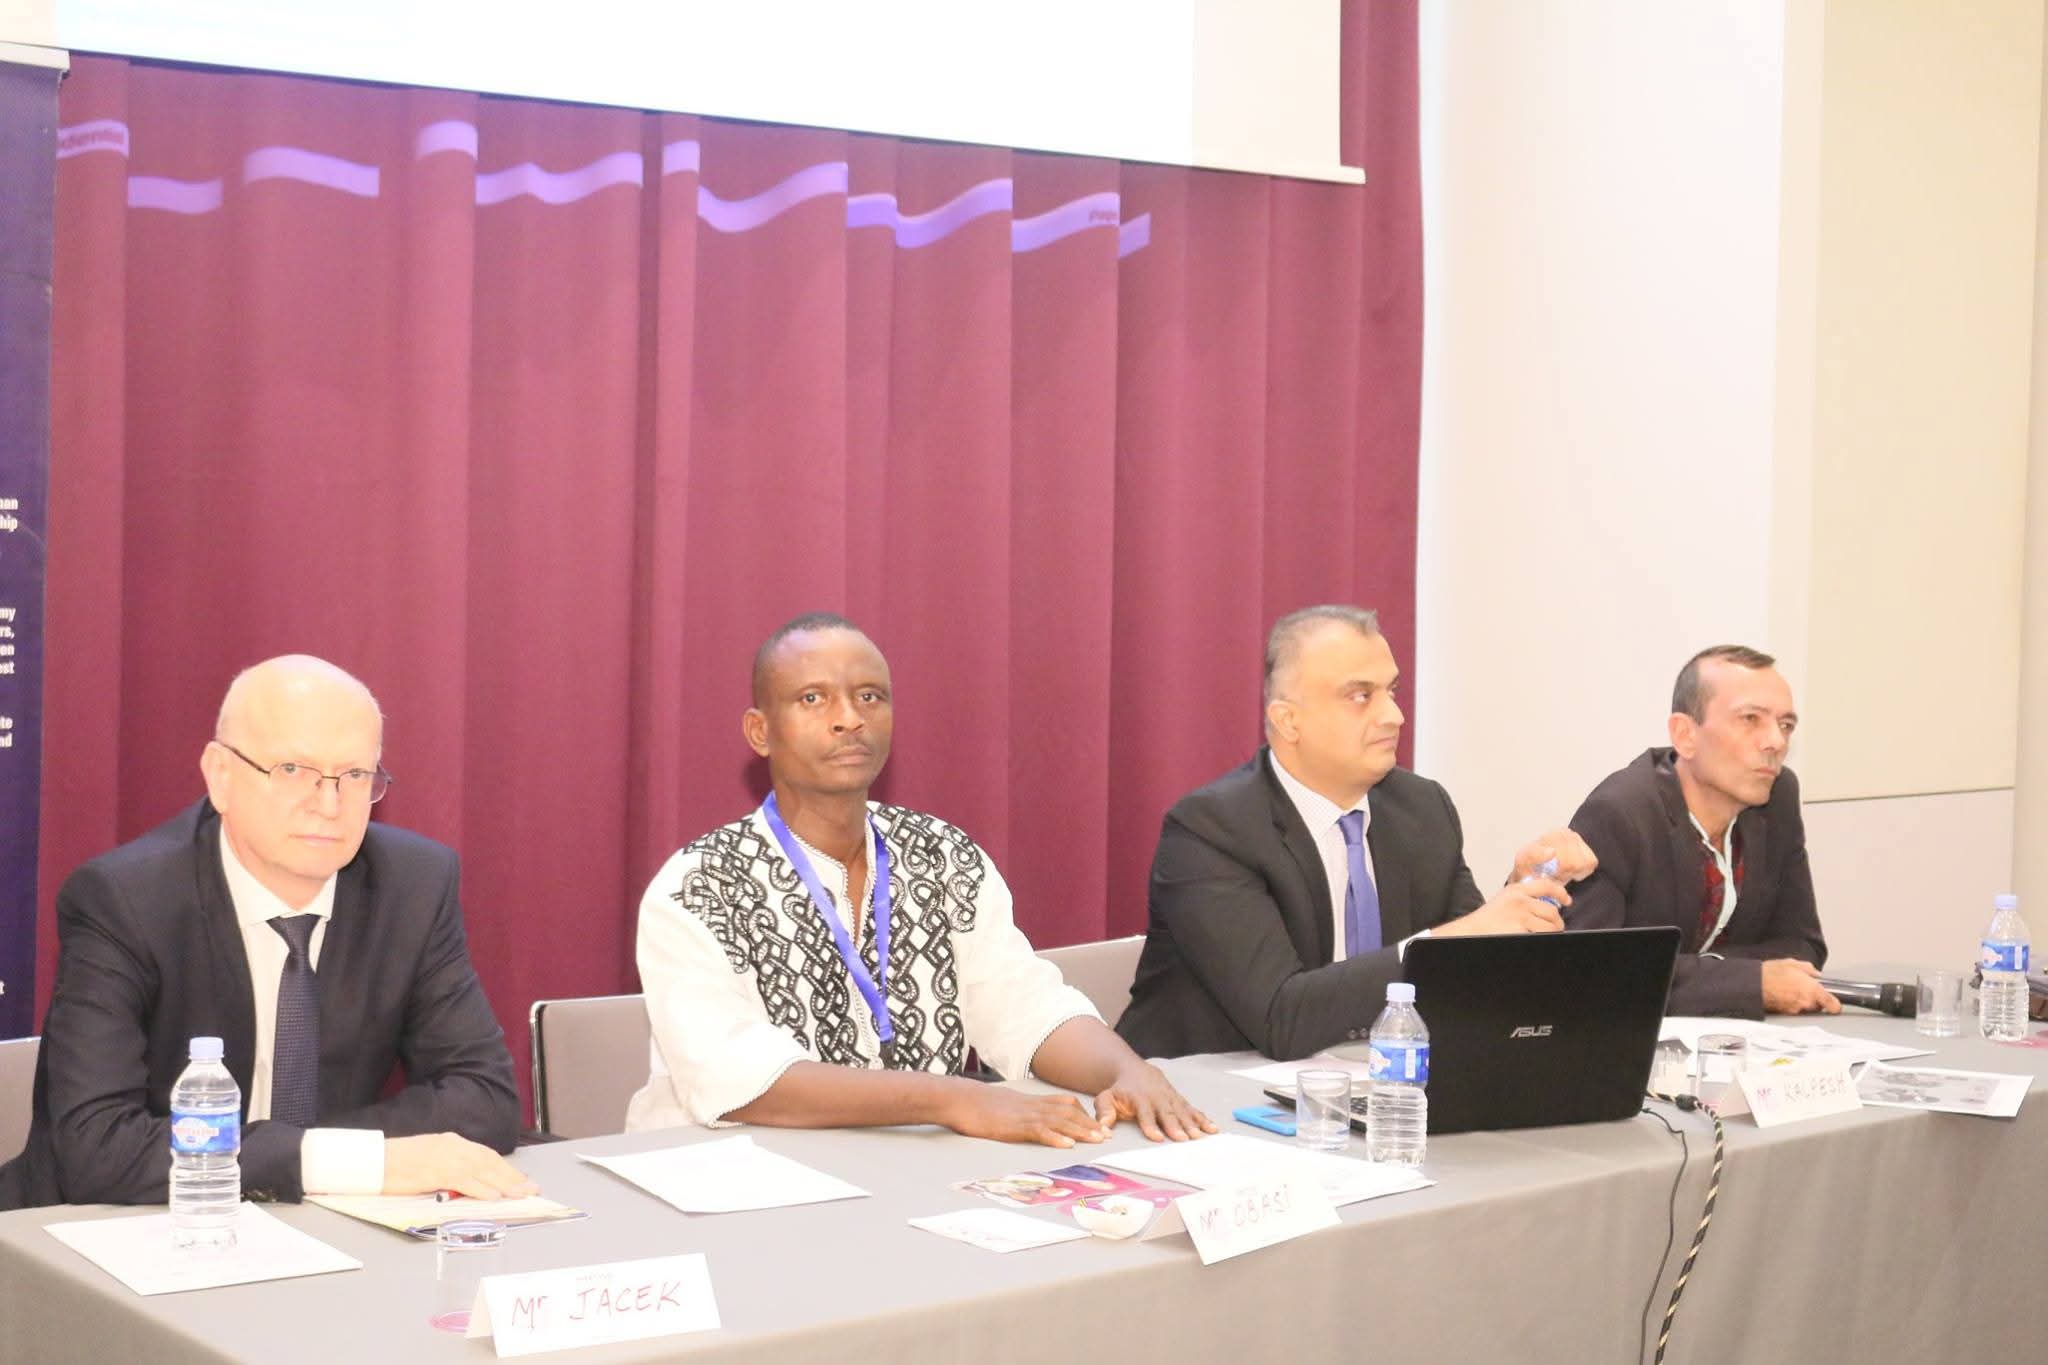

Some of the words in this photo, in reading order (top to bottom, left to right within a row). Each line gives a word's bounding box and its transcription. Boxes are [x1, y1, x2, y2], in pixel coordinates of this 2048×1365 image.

[1509, 1024, 1553, 1039] ASUS
[511, 1295, 548, 1330] Mr
[569, 1279, 682, 1320] JACEK
